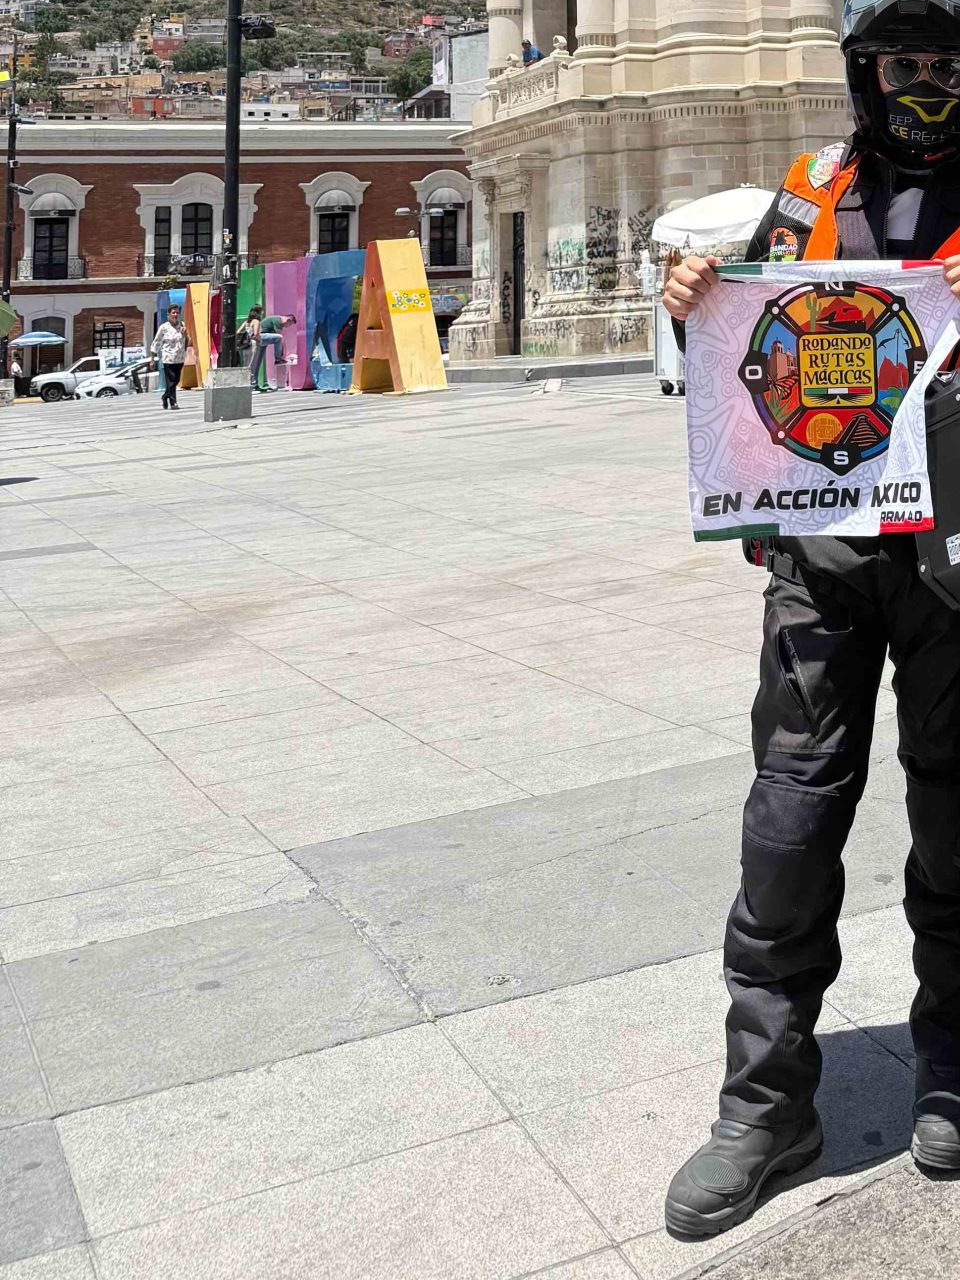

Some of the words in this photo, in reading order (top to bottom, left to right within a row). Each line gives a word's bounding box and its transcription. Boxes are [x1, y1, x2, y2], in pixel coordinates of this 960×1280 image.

[745, 366, 762, 379] O
[914, 361, 925, 375] E
[833, 451, 849, 465] S
[703, 492, 742, 517] EN
[753, 480, 861, 511] ACCIÓN
